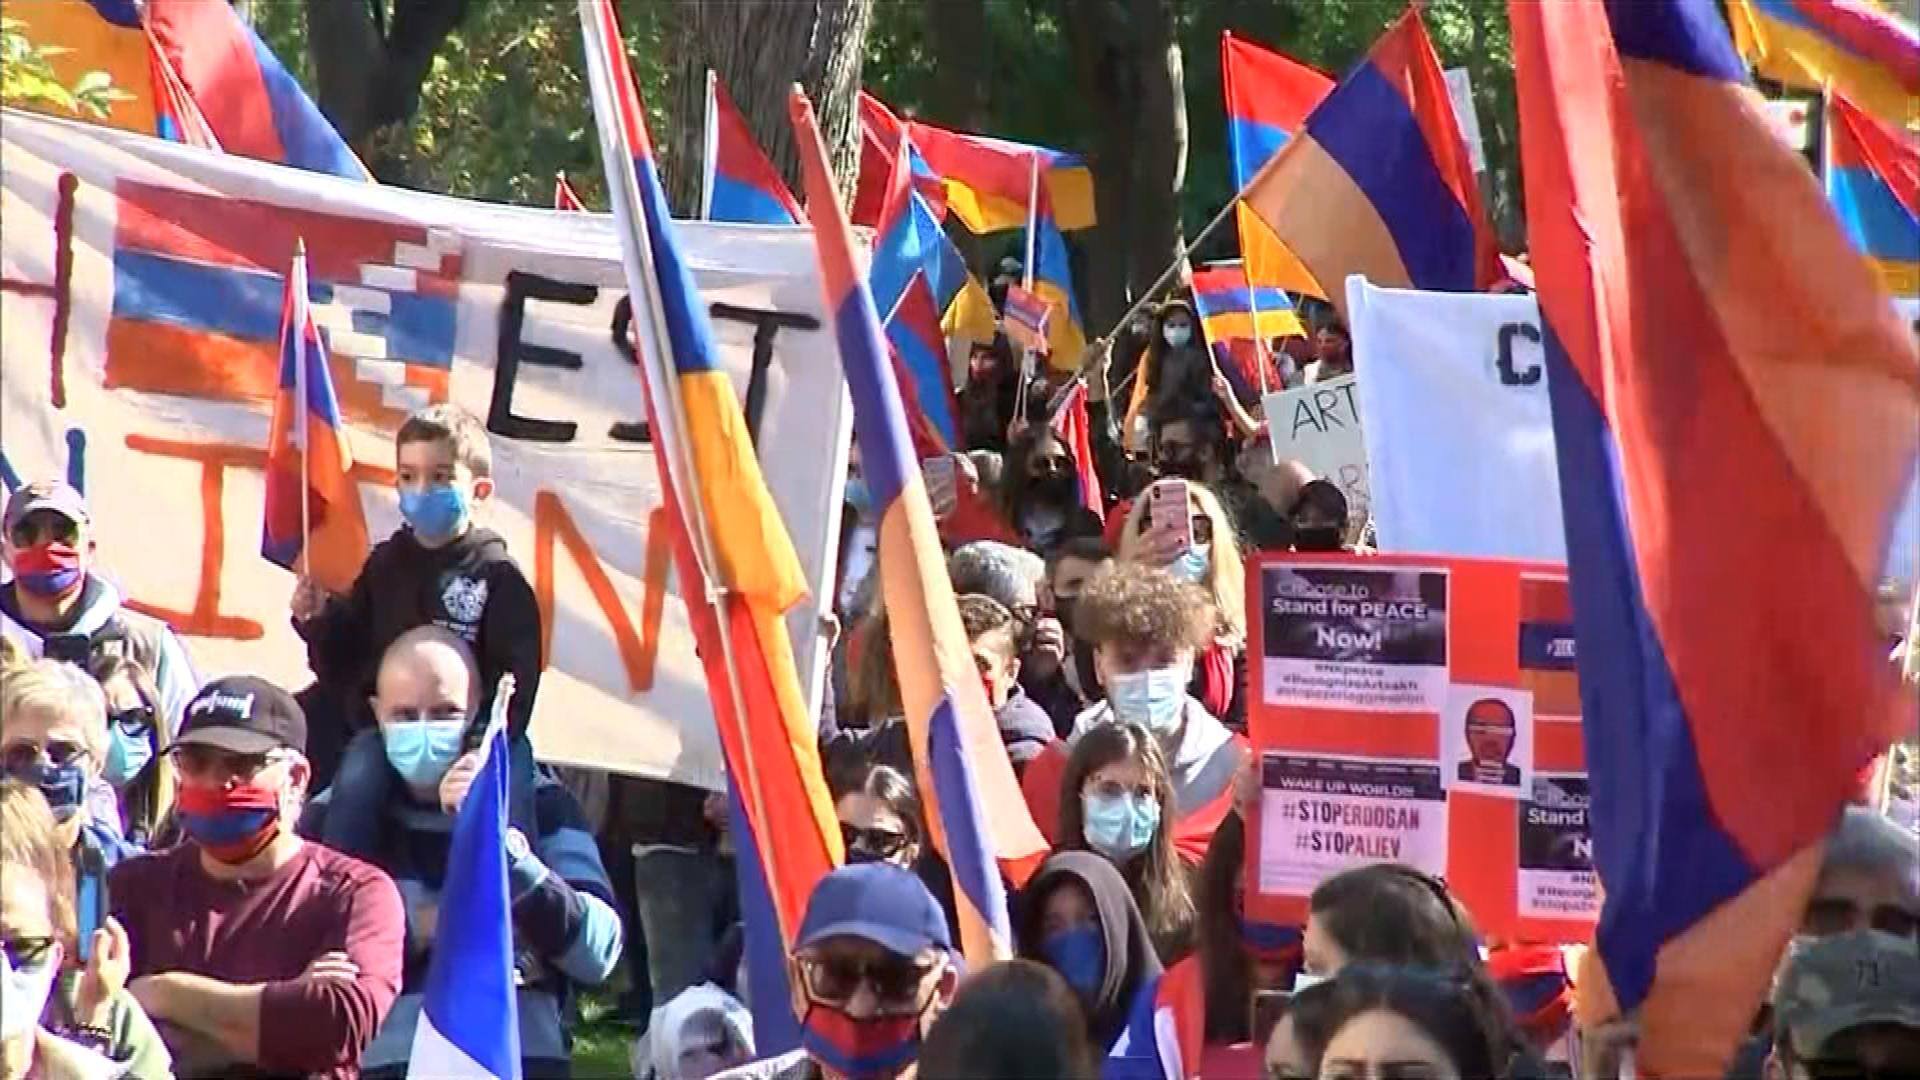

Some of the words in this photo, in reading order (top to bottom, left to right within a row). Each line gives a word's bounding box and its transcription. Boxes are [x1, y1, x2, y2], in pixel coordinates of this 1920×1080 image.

[1272, 599, 1327, 615] Stand
[1331, 599, 1356, 616] for
[1360, 602, 1428, 620] PEACE
[1317, 626, 1382, 651] Now!
[1280, 776, 1323, 791] WAKE
[1326, 782, 1347, 793] UP
[1282, 799, 1420, 830] #STOPERDOGAN
[1527, 808, 1584, 825] Stand
[1296, 829, 1400, 859] #STOPALIEV
